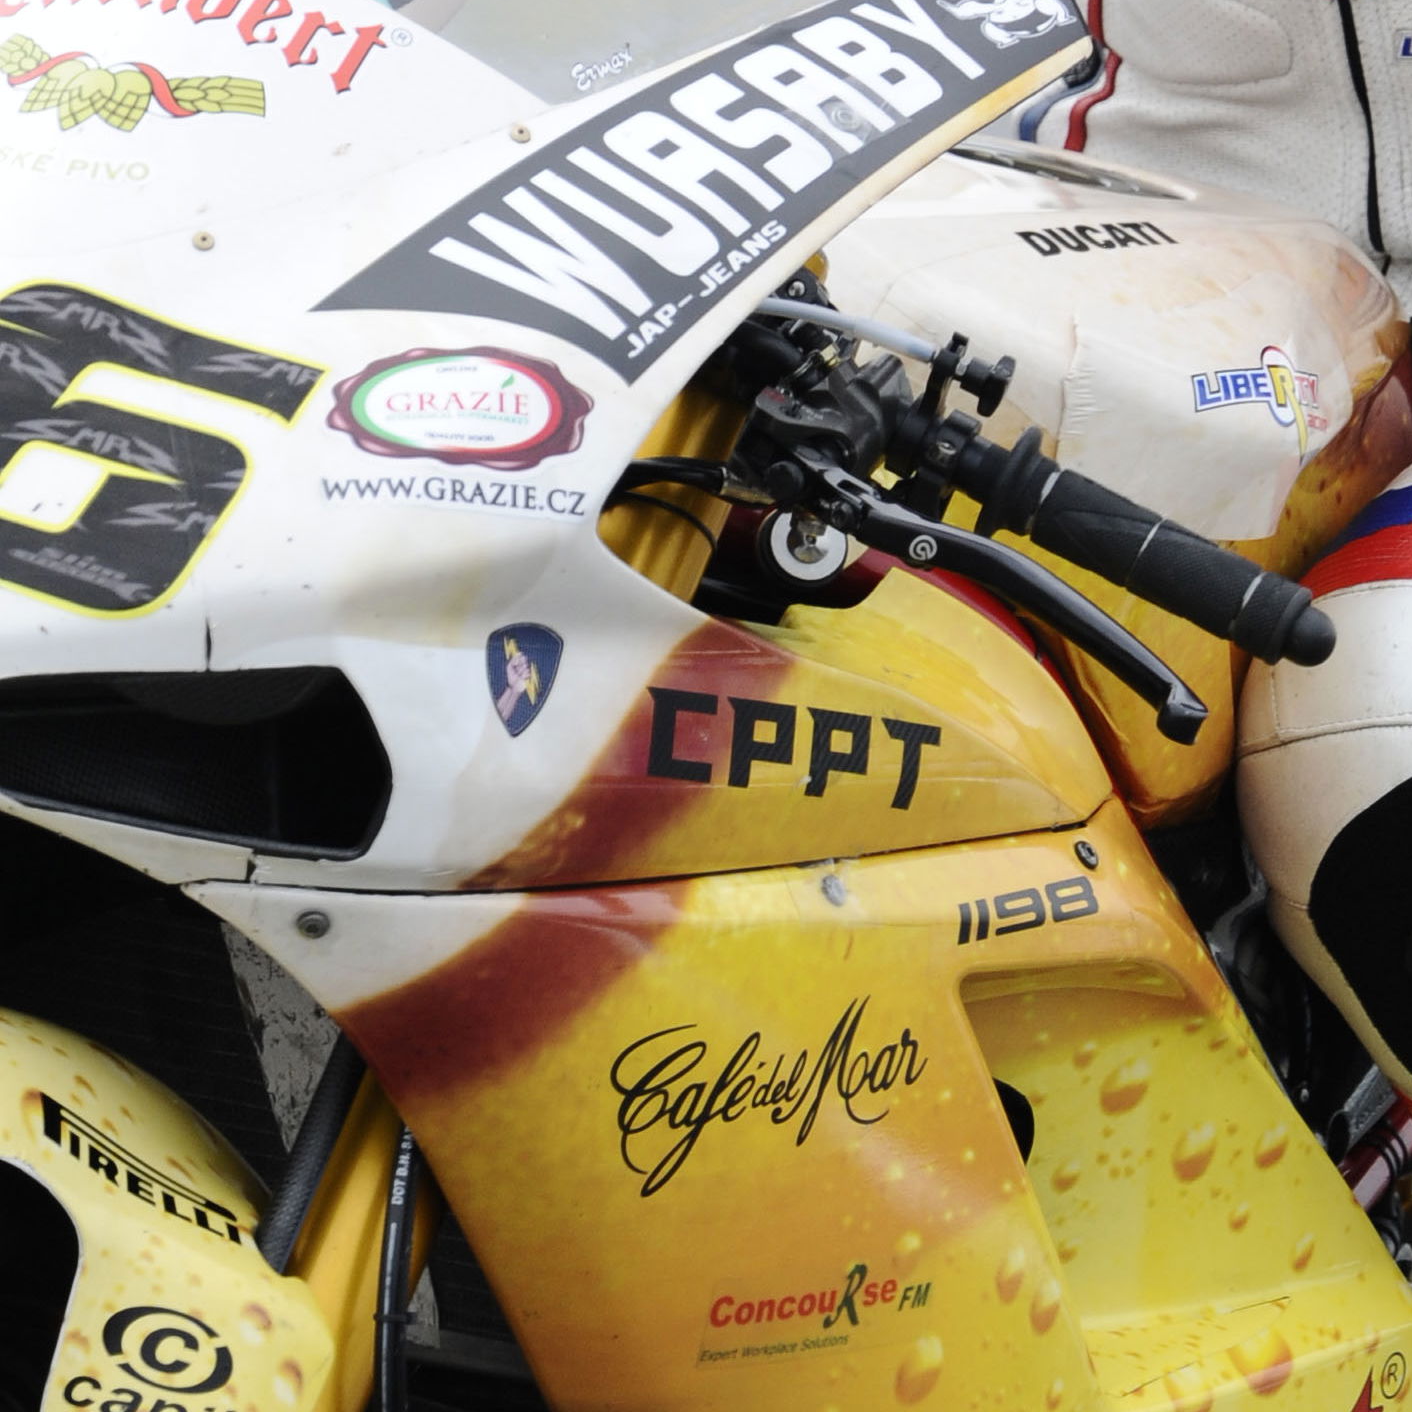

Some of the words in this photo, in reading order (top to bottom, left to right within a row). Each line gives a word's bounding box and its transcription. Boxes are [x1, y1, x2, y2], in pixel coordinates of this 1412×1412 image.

[1014, 221, 1180, 258] DUCATI
[320, 476, 587, 517] WWW.GRAZIE.CZ
[647, 686, 942, 812] CPPT
[957, 875, 1100, 945] 1198
[751, 1052, 808, 1110] del
[771, 994, 929, 1147] Mar
[610, 1024, 766, 1199] Café
[39, 1090, 242, 1246] PIRELLI
[897, 1282, 932, 1312] FM
[699, 1348, 738, 1363] Expert
[741, 1340, 798, 1359] Workplace
[800, 1334, 849, 1352] Solutions
